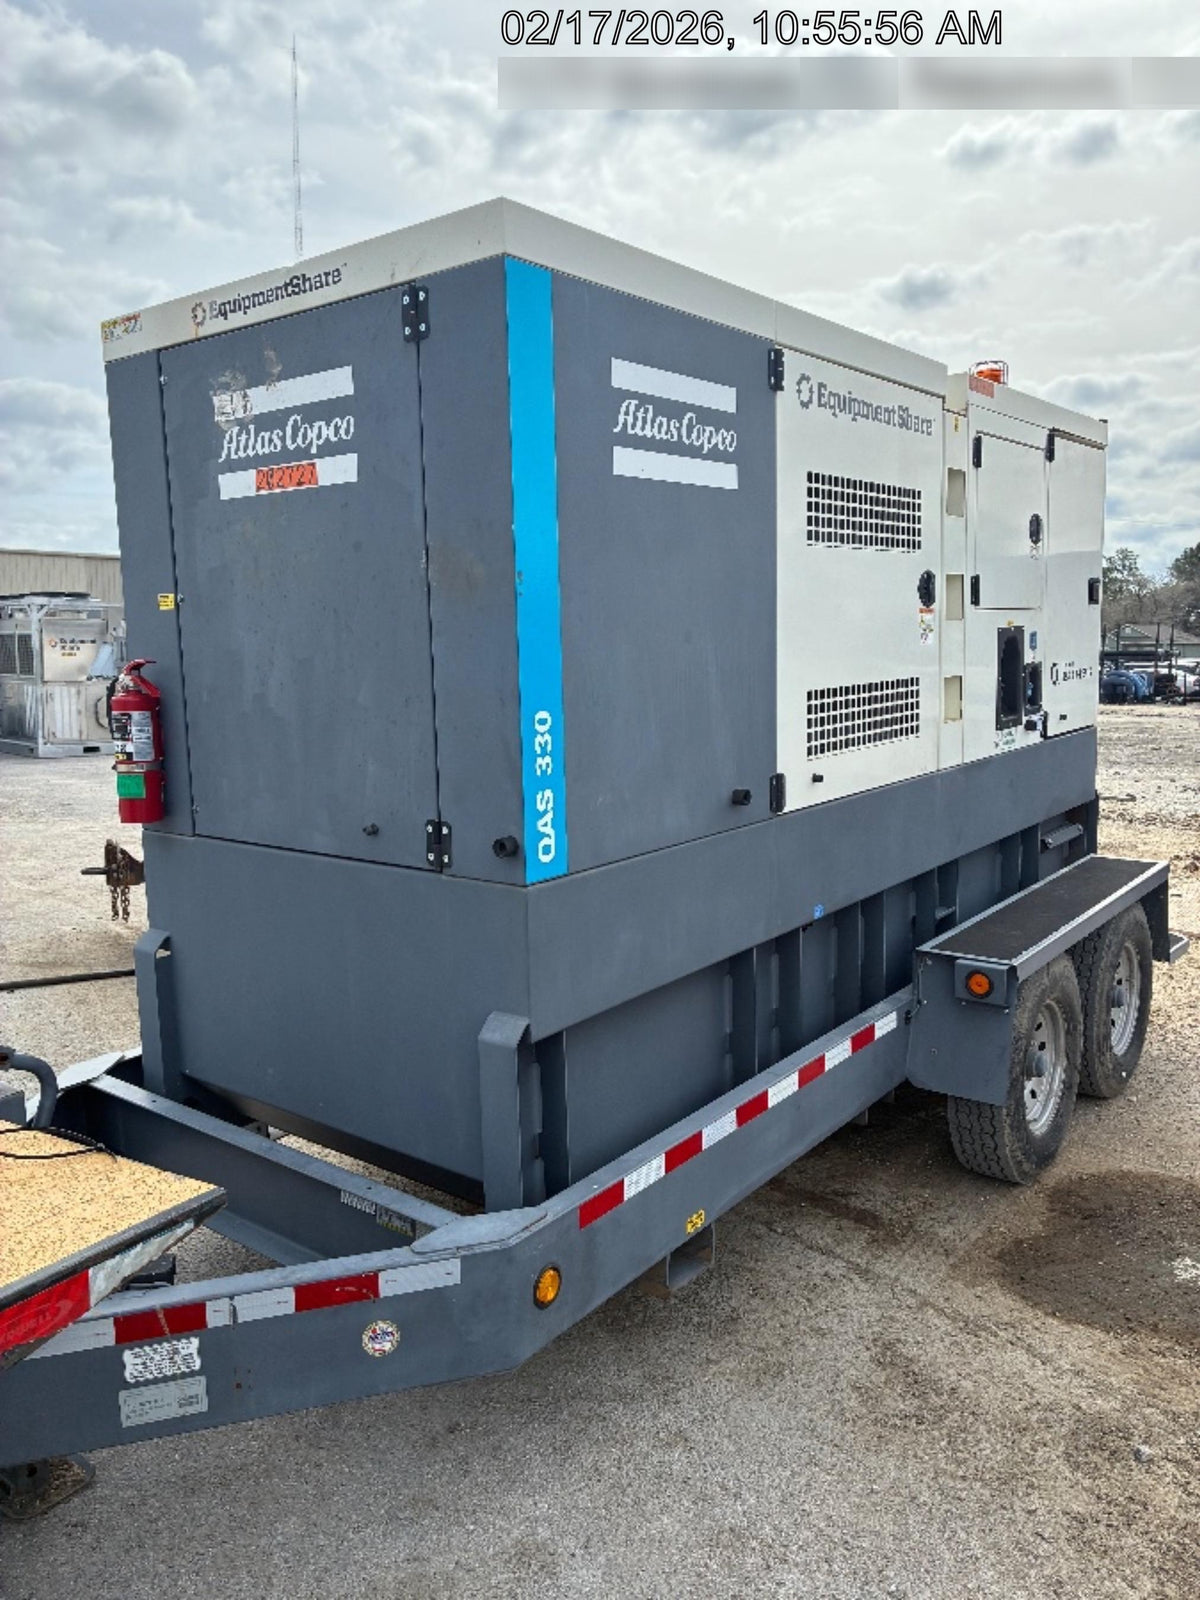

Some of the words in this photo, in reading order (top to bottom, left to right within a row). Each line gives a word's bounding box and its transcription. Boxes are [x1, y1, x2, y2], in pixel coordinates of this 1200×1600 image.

[209, 266, 342, 321] EquipmentShare
[613, 398, 680, 442] Atlas
[680, 411, 738, 454] Copco
[816, 383, 934, 436] EquipmentShare
[217, 424, 284, 463] Atlas
[285, 413, 355, 454] Copco
[534, 710, 552, 777] 330
[536, 788, 556, 864] QAS
